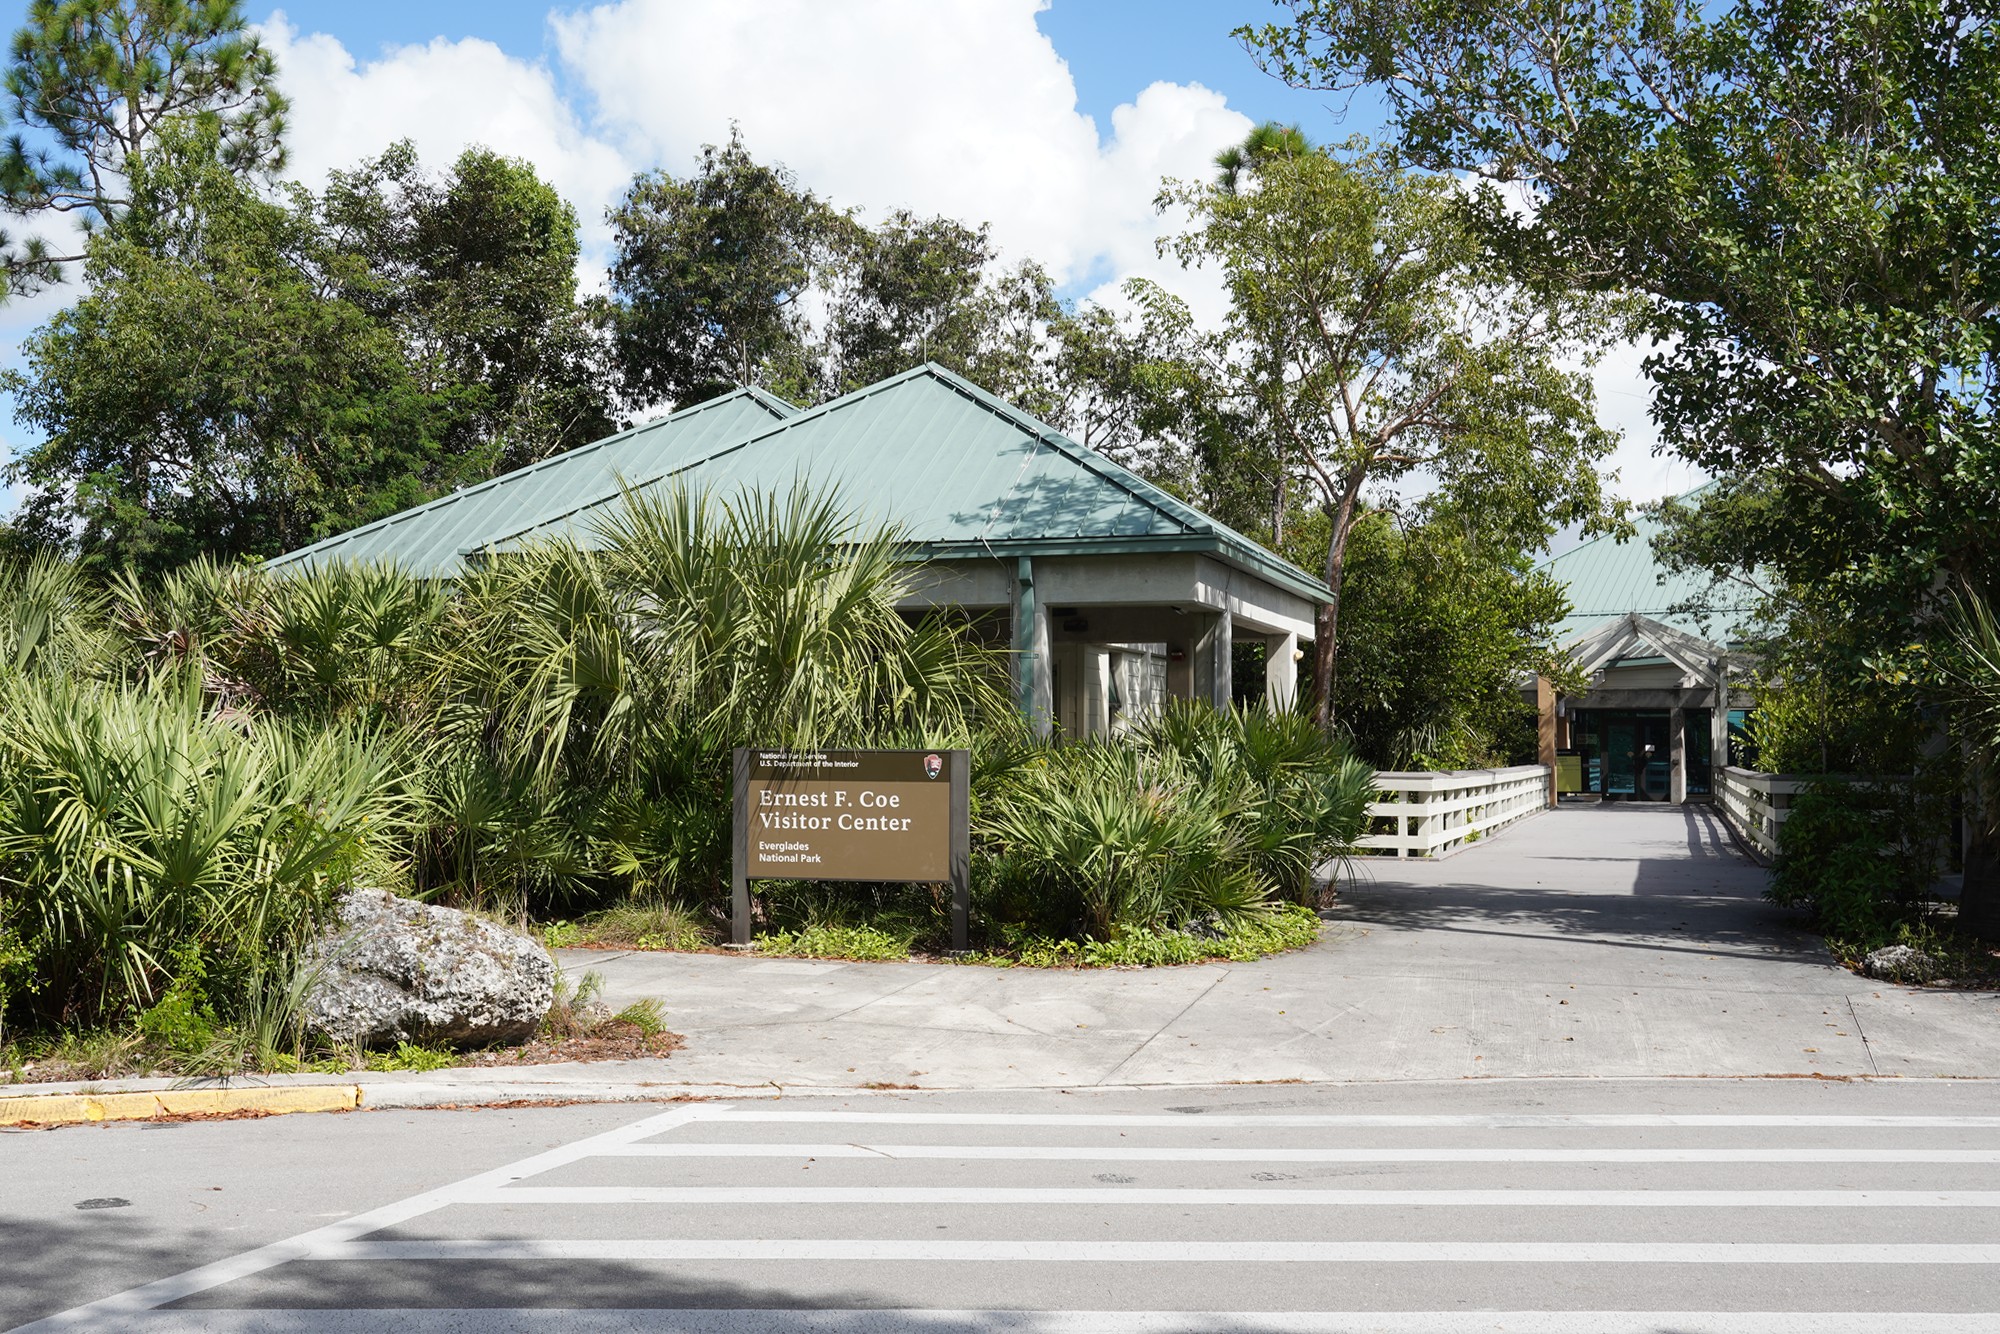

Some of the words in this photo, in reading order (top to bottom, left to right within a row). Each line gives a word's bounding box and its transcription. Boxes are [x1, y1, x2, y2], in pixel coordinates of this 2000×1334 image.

[759, 790, 828, 807] Ernest
[834, 791, 853, 807] F.
[859, 791, 900, 808] Coe
[760, 812, 832, 830] Visitor
[838, 813, 912, 831] Center
[759, 841, 809, 852] Everglades
[759, 853, 798, 863] National
[800, 854, 821, 863] Park
